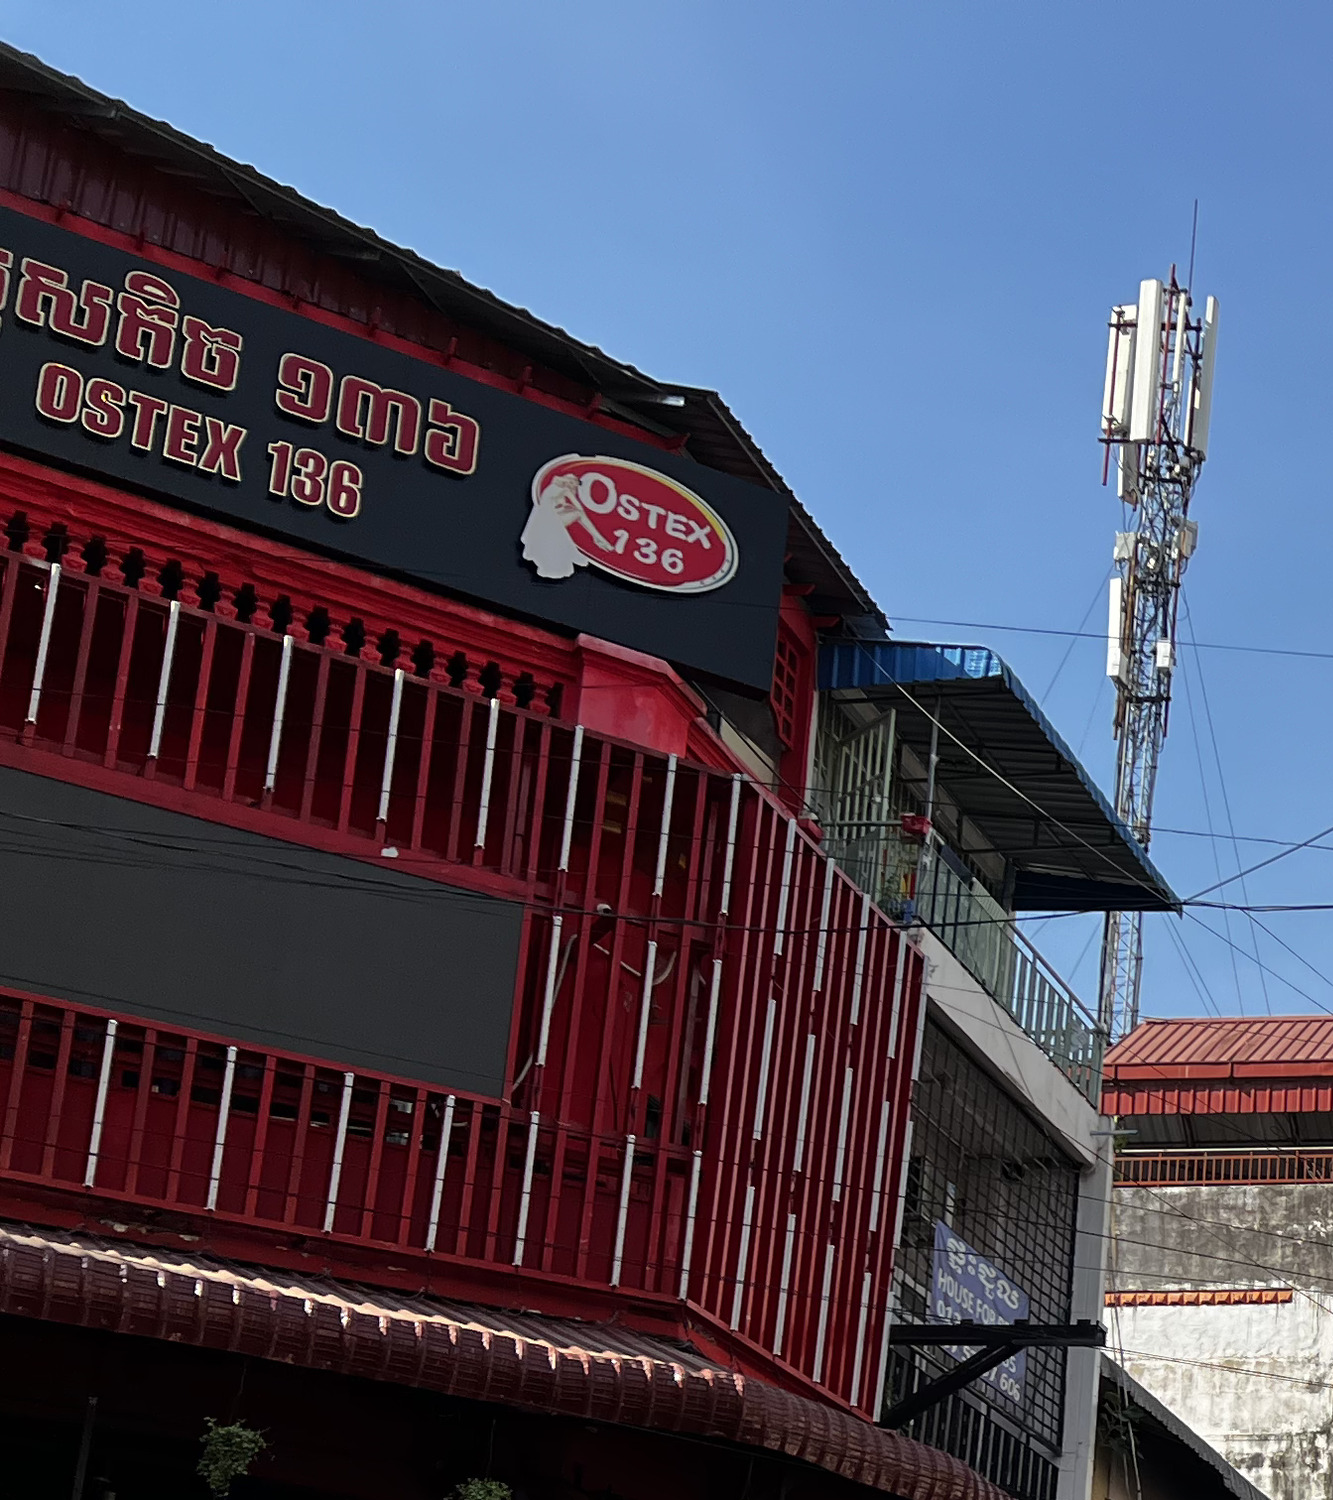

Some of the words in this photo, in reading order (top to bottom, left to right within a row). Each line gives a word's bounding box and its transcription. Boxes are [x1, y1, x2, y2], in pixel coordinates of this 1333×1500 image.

[36, 362, 249, 482] OSTEX
[267, 440, 363, 518] 136
[611, 527, 684, 575] 136
[937, 1267, 974, 1314] HOUSE
